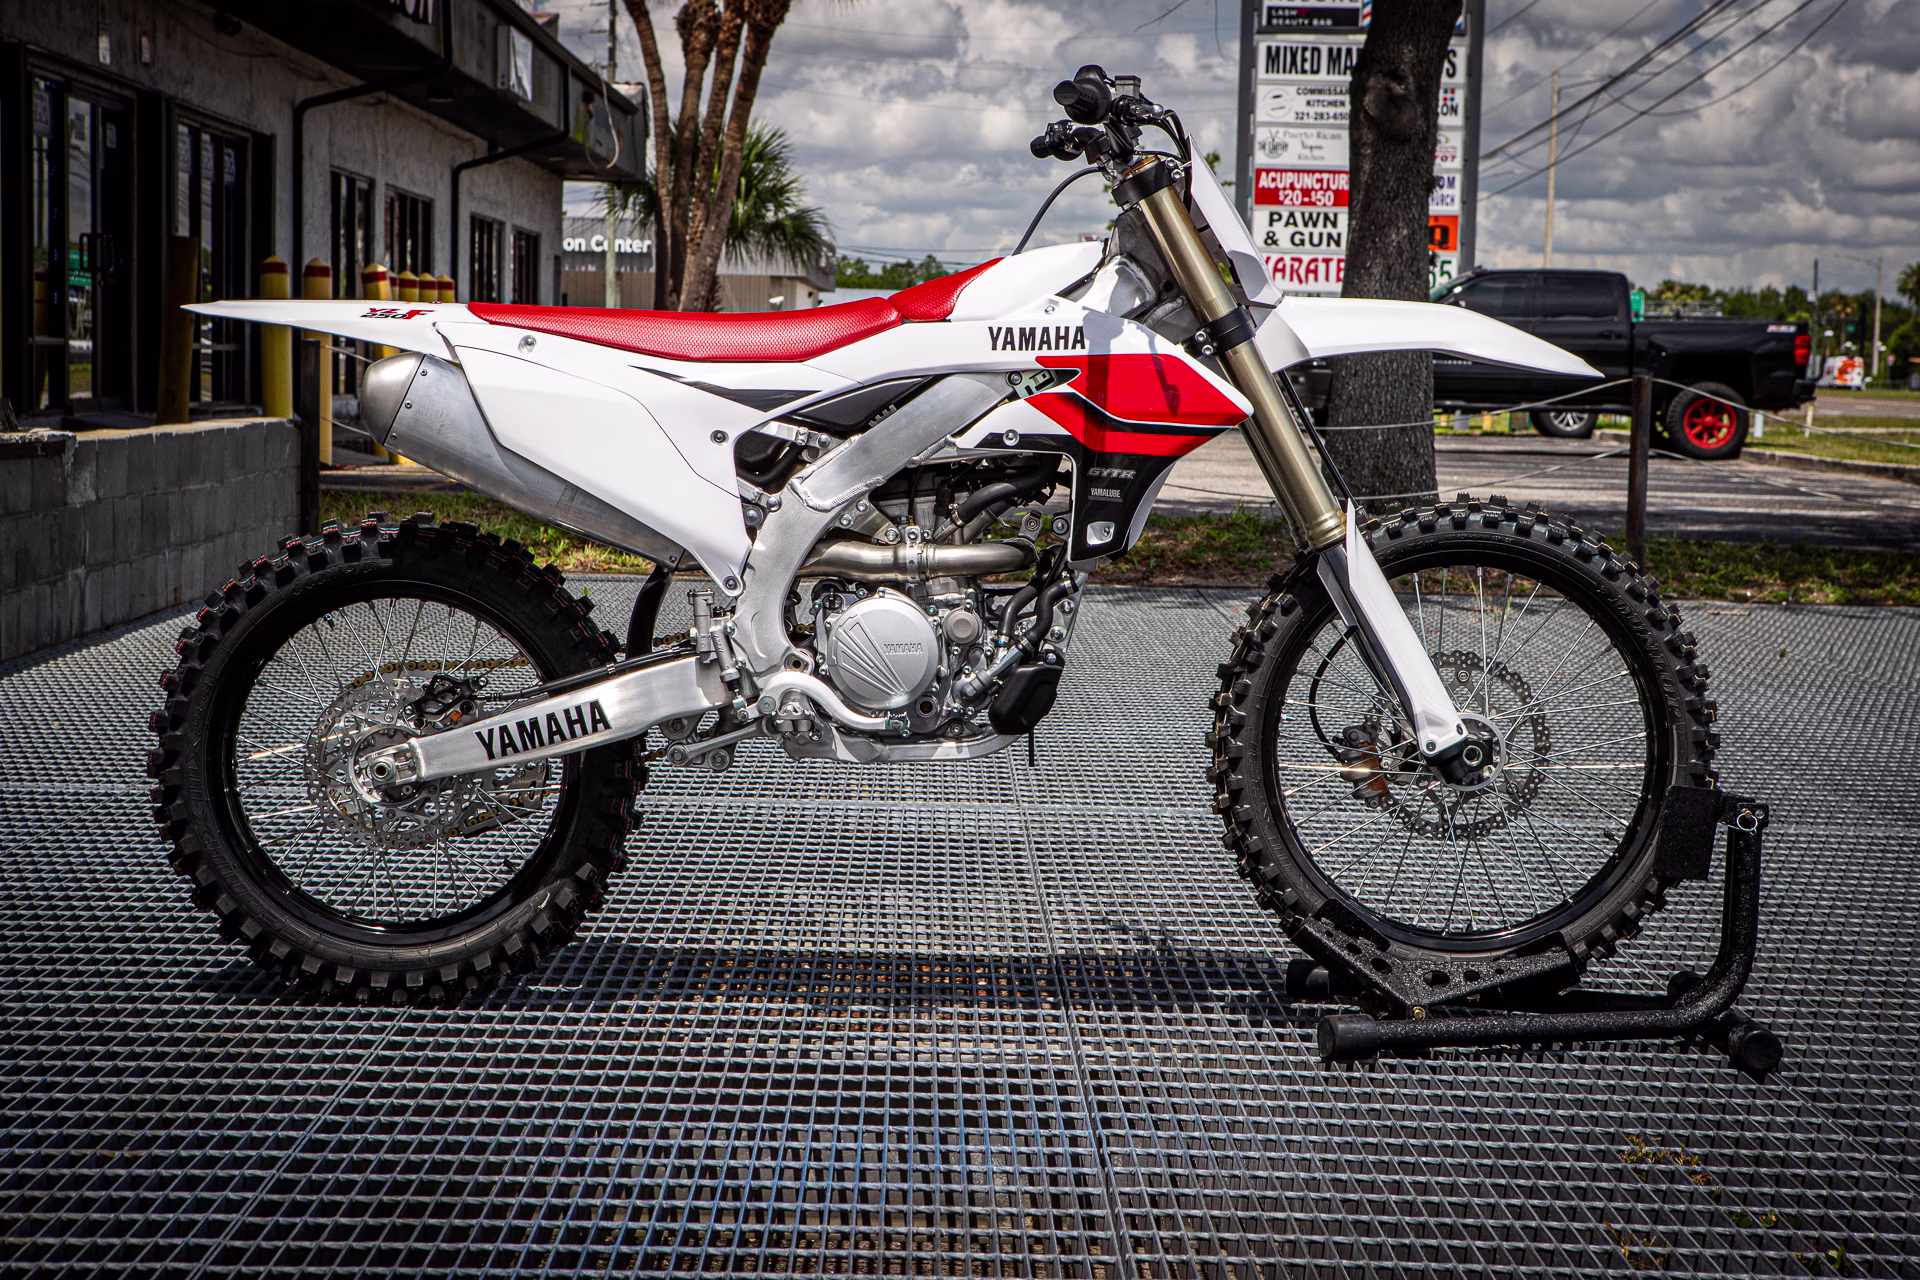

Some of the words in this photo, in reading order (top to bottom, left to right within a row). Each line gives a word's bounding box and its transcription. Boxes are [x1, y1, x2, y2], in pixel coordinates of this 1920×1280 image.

[1265, 45, 1321, 75] MIXED
[1305, 99, 1346, 108] KITCHEN
[1268, 211, 1338, 229] PAWN
[1263, 232, 1280, 247] &
[1290, 232, 1342, 248] GUN
[988, 326, 1087, 351] YAMAHA
[1087, 466, 1137, 480] GYTR
[1090, 487, 1121, 498] YAMALUBE
[884, 642, 923, 655] YAMAHA
[1607, 592, 1687, 722] DUNLOP
[474, 698, 613, 761] YAMAHA
